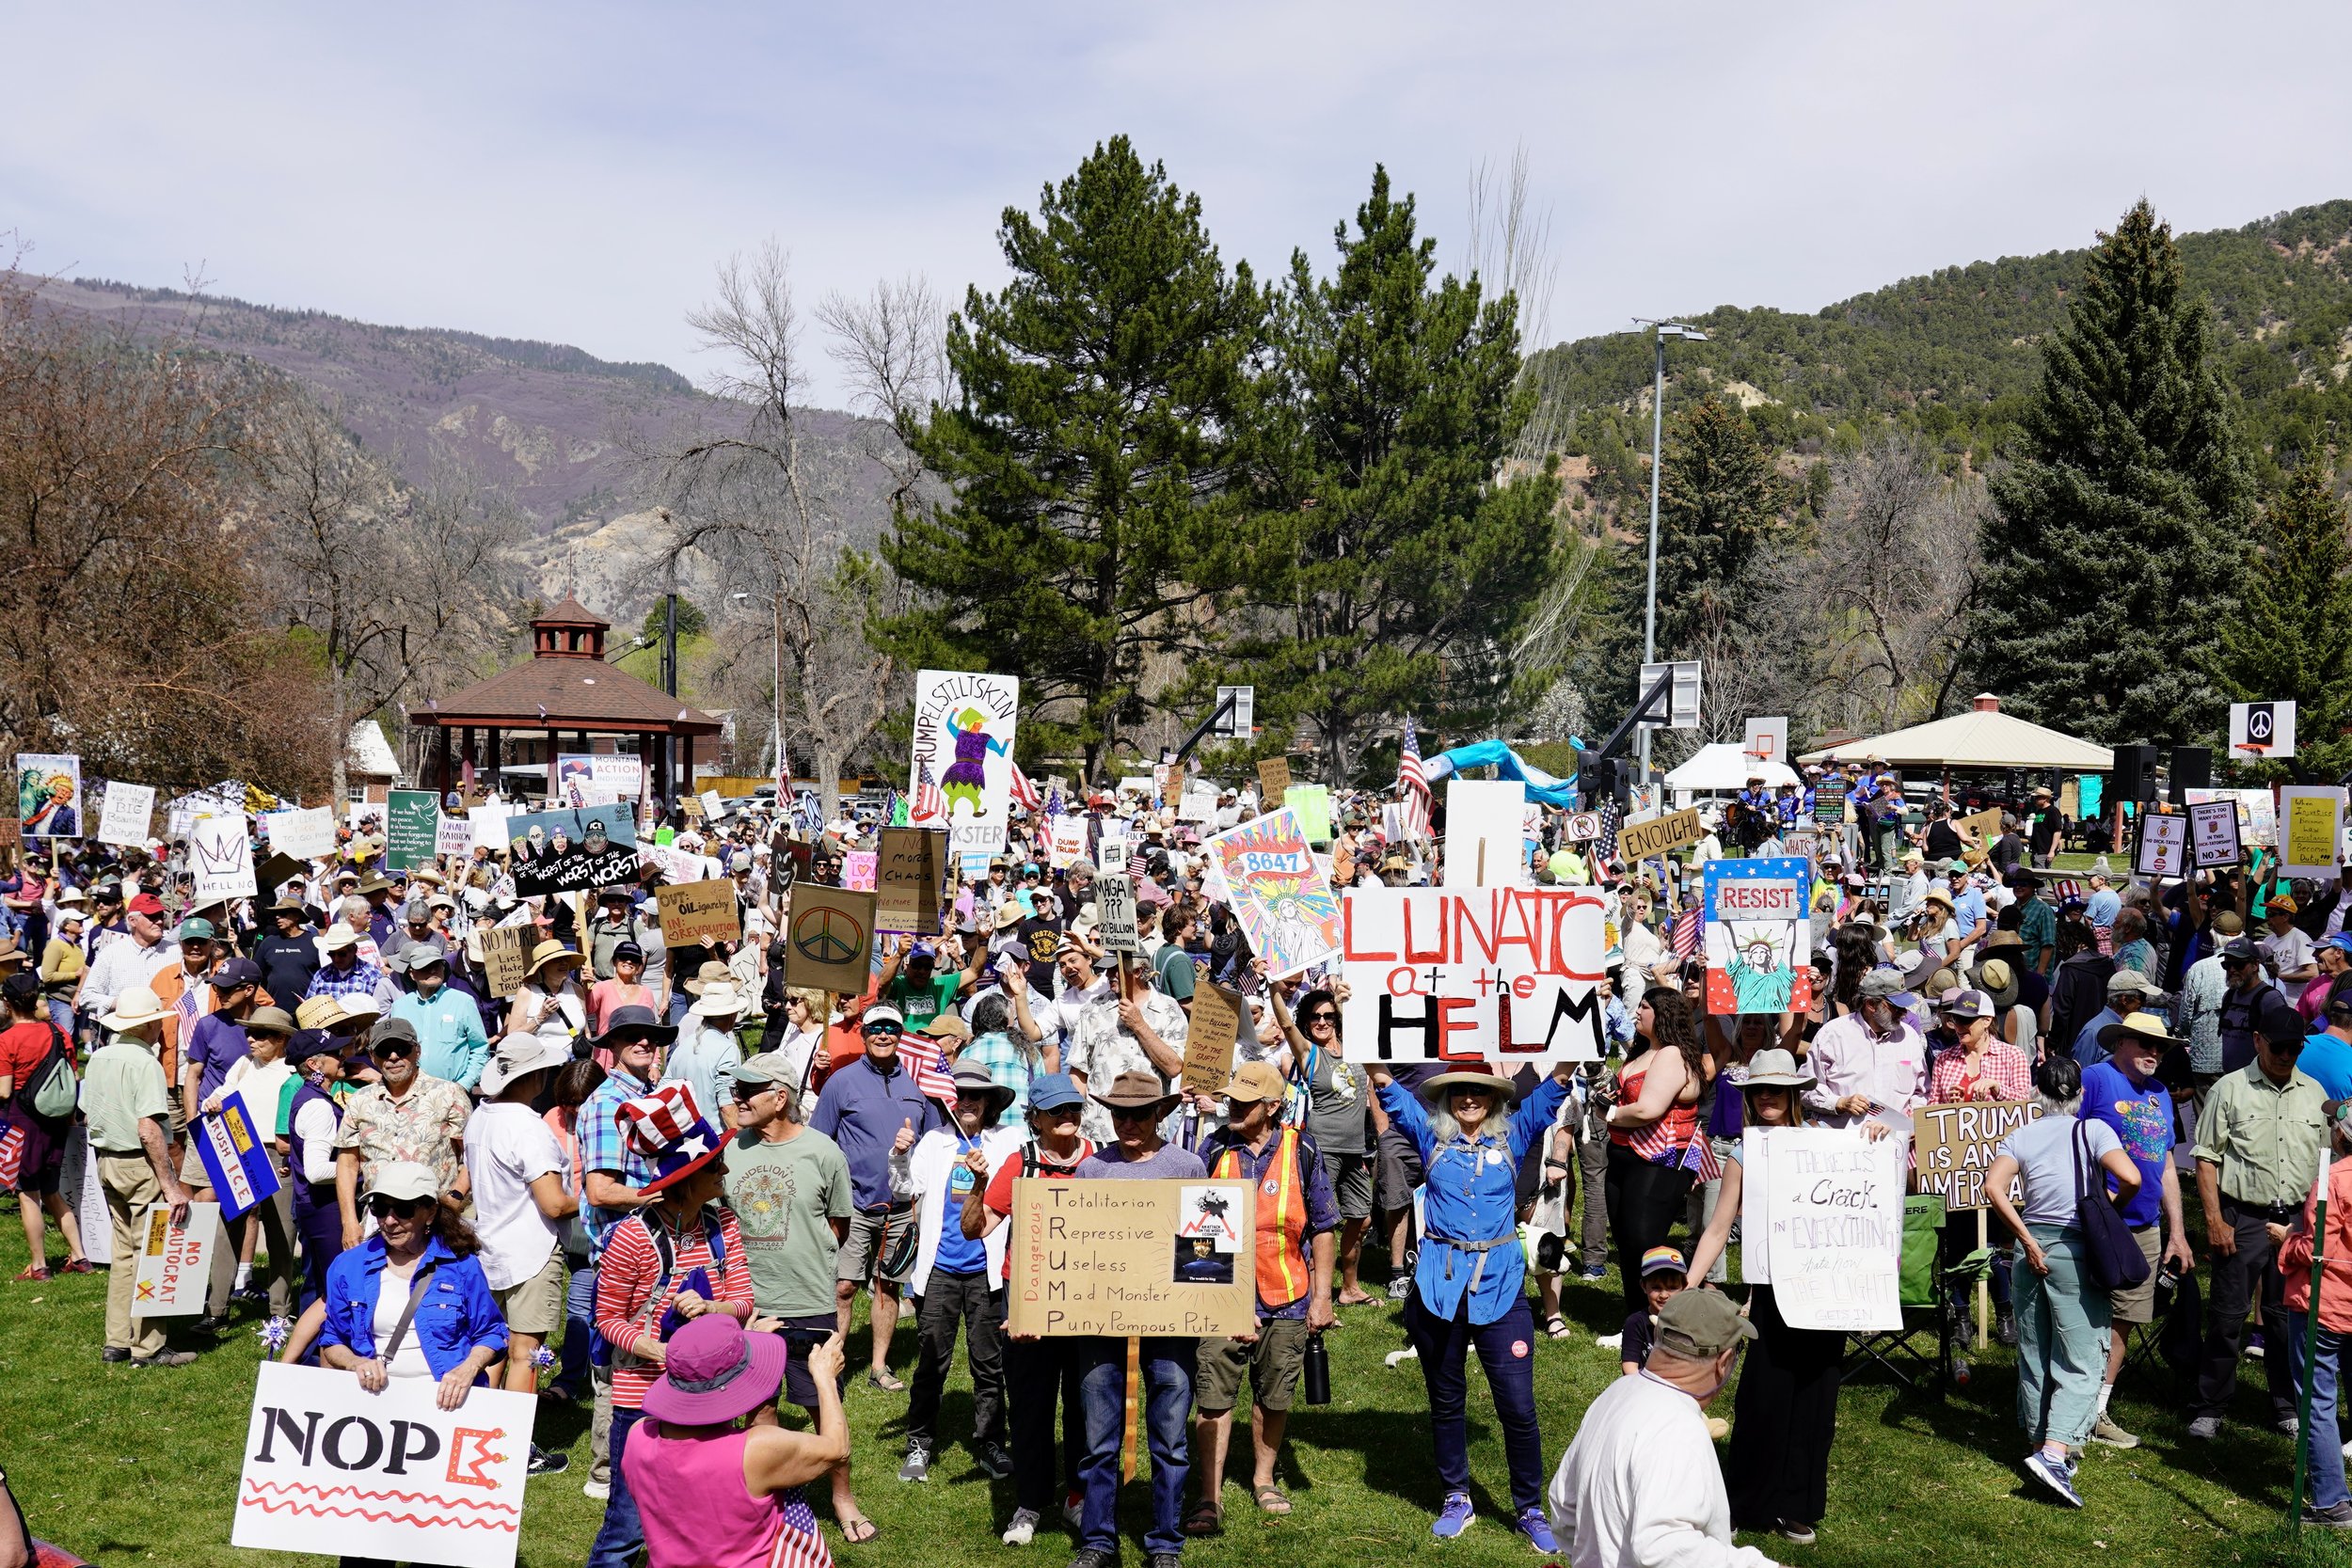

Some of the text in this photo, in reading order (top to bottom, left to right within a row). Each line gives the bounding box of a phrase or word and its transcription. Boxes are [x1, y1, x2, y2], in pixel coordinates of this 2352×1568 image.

[116, 801, 143, 815] BIG
[597, 794, 614, 805] END
[299, 814, 319, 823] LIKE
[442, 822, 467, 832] DRAFT
[406, 838, 425, 847] belong
[438, 832, 470, 841] BARRON
[903, 835, 927, 850] NO
[1057, 838, 1080, 847] DUMP
[1625, 813, 1700, 858] ENOUGH!!
[2292, 832, 2329, 842] Resistance
[440, 841, 467, 850] TRUMP
[1056, 845, 1080, 854] TRUMP
[2296, 843, 2328, 853] Becomes
[892, 853, 933, 863] MORE
[1247, 852, 1298, 872] 8647
[2201, 851, 2214, 860] NO
[515, 860, 537, 873] WORST
[528, 867, 540, 876] THE
[536, 859, 563, 880] WORST
[563, 859, 572, 867] OF
[557, 850, 621, 886] WORST OF THE
[590, 852, 640, 886] WORST
[884, 870, 932, 881] CHAOS
[1093, 879, 1127, 898] MAGA
[1724, 886, 1794, 909] RESIST
[659, 891, 690, 908] OUT:
[678, 901, 730, 916] OILigarchy
[879, 897, 890, 907] NO
[893, 898, 912, 907] MORE
[1104, 899, 1122, 920] ???
[666, 918, 686, 930] IN:
[679, 922, 741, 940] REVOLUTION
[1108, 922, 1136, 934] BILLION
[480, 925, 539, 953] NO MORE
[1031, 929, 1061, 941] PROTECT
[1343, 886, 1605, 981] LUNATIC
[1104, 939, 1136, 947] ARGENTINA
[498, 954, 521, 963] Lies
[501, 963, 525, 974] Hate
[1387, 966, 1537, 999] at the
[1378, 986, 1606, 1063] HELM
[1191, 1041, 1208, 1052] STOP
[1785, 1149, 1878, 1174] THERE IS
[1929, 1146, 1953, 1169] IS
[732, 1164, 798, 1198] DANDELION DAY
[1048, 1187, 1155, 1209] Totalitarian
[1792, 1179, 1878, 1210] a Crack
[1048, 1216, 1155, 1245] Repressive
[1774, 1211, 1895, 1257] IN EVERYTHING
[184, 1242, 201, 1266] NO
[1024, 1202, 1046, 1303] Dangerous
[1048, 1250, 1127, 1272] Useless
[1832, 1251, 1863, 1270] how
[159, 1227, 185, 1305] AUTOCRAT
[1048, 1280, 1170, 1302] Mad Monster
[1783, 1272, 1893, 1305] THE LIGHT
[1048, 1309, 1221, 1335] Puny Pompous Putz
[1816, 1309, 1873, 1322] GETS IN
[254, 1406, 508, 1490] NOPE
